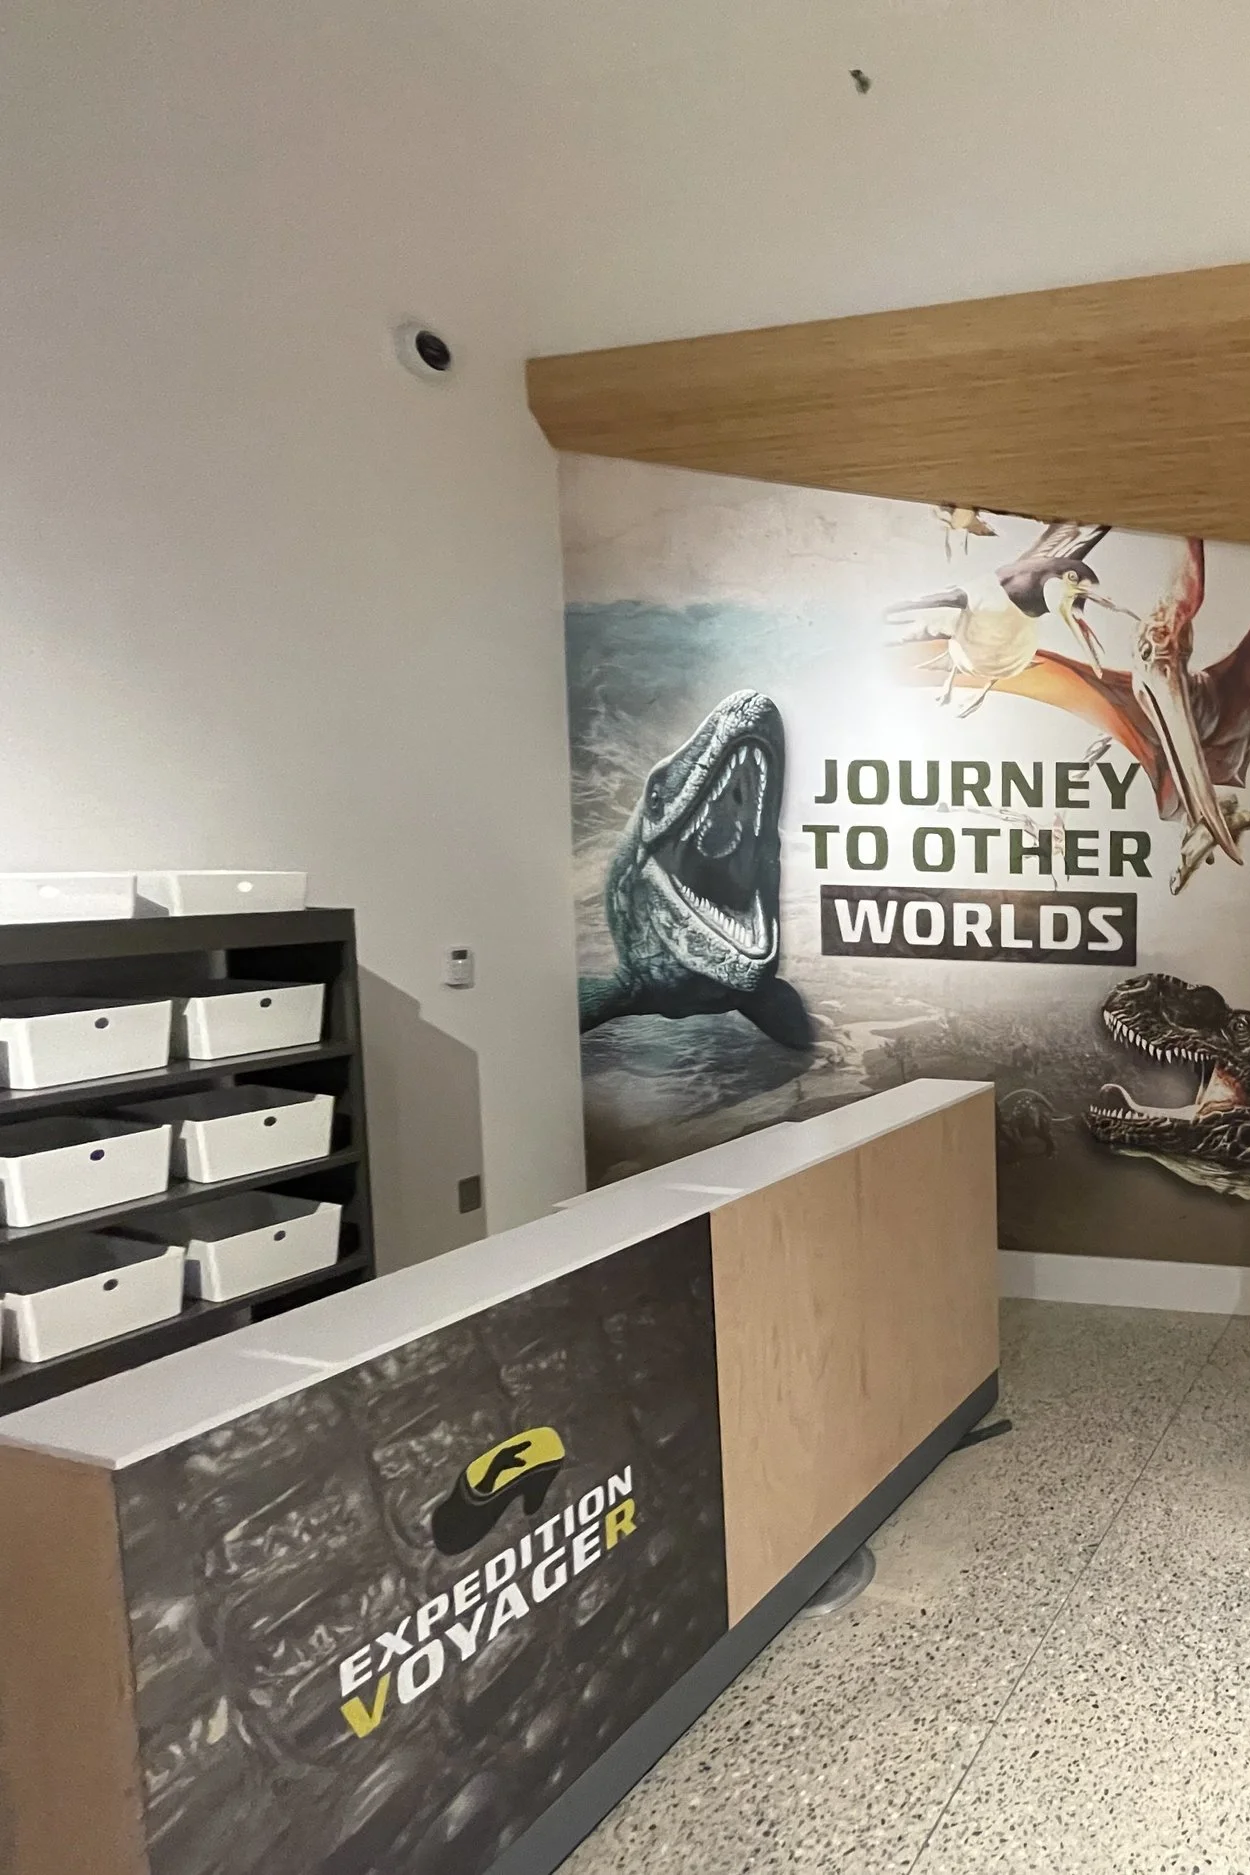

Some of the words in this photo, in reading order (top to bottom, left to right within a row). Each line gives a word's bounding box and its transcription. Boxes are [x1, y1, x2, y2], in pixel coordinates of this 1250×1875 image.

[814, 759, 1141, 810] JOURNEY
[802, 824, 889, 870] TO
[912, 826, 1152, 878] OTHER
[834, 898, 1123, 952] WORLDS
[339, 1465, 632, 1697] EXPEDITION
[340, 1498, 637, 1738] VOYAGER
